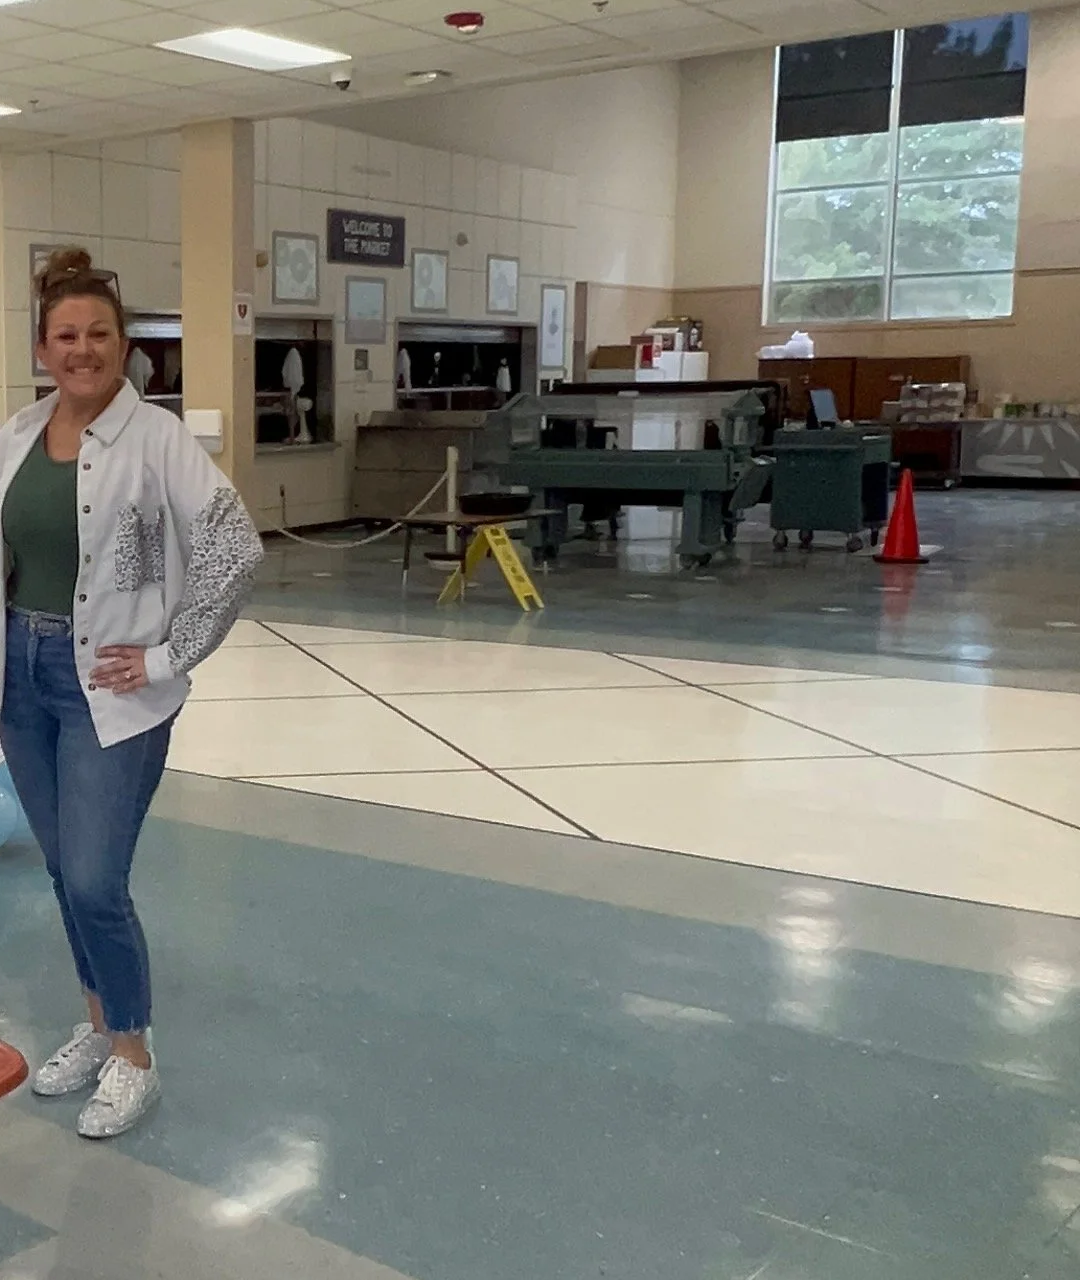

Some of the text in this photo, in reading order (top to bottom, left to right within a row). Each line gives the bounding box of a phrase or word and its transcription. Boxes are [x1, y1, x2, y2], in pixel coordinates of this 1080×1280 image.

[342, 218, 393, 238] WELCOME TO
[343, 238, 390, 256] THE MARKET
